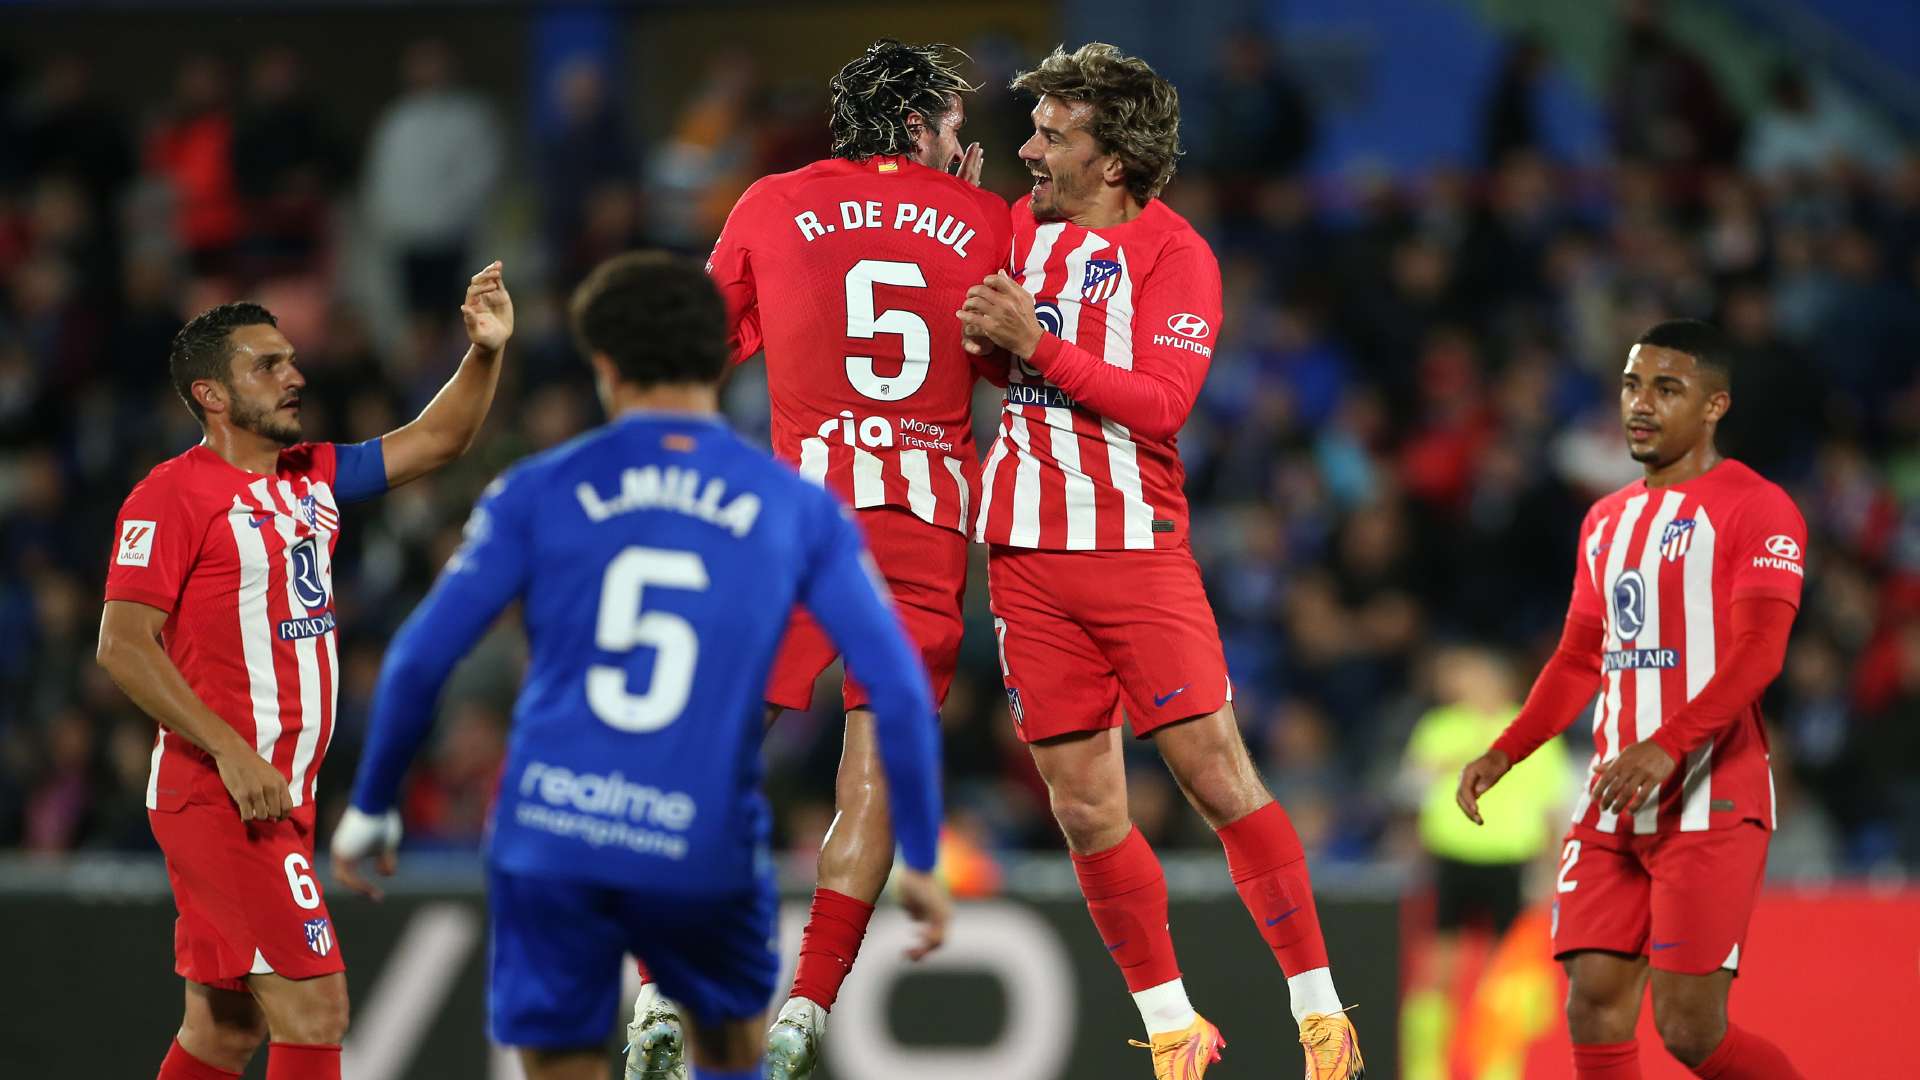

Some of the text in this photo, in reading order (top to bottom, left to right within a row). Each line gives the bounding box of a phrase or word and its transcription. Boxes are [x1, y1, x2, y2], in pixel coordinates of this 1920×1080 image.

[795, 200, 977, 259] R. DE PAUL
[845, 259, 931, 402] 5
[1052, 389, 1076, 407] AI
[817, 410, 894, 448] ria
[899, 432, 953, 453] Transfer
[585, 545, 710, 734] 5
[1642, 650, 1675, 668] AIR
[518, 761, 697, 832] realme
[284, 853, 320, 909] 6
[1557, 839, 1582, 893] 2
